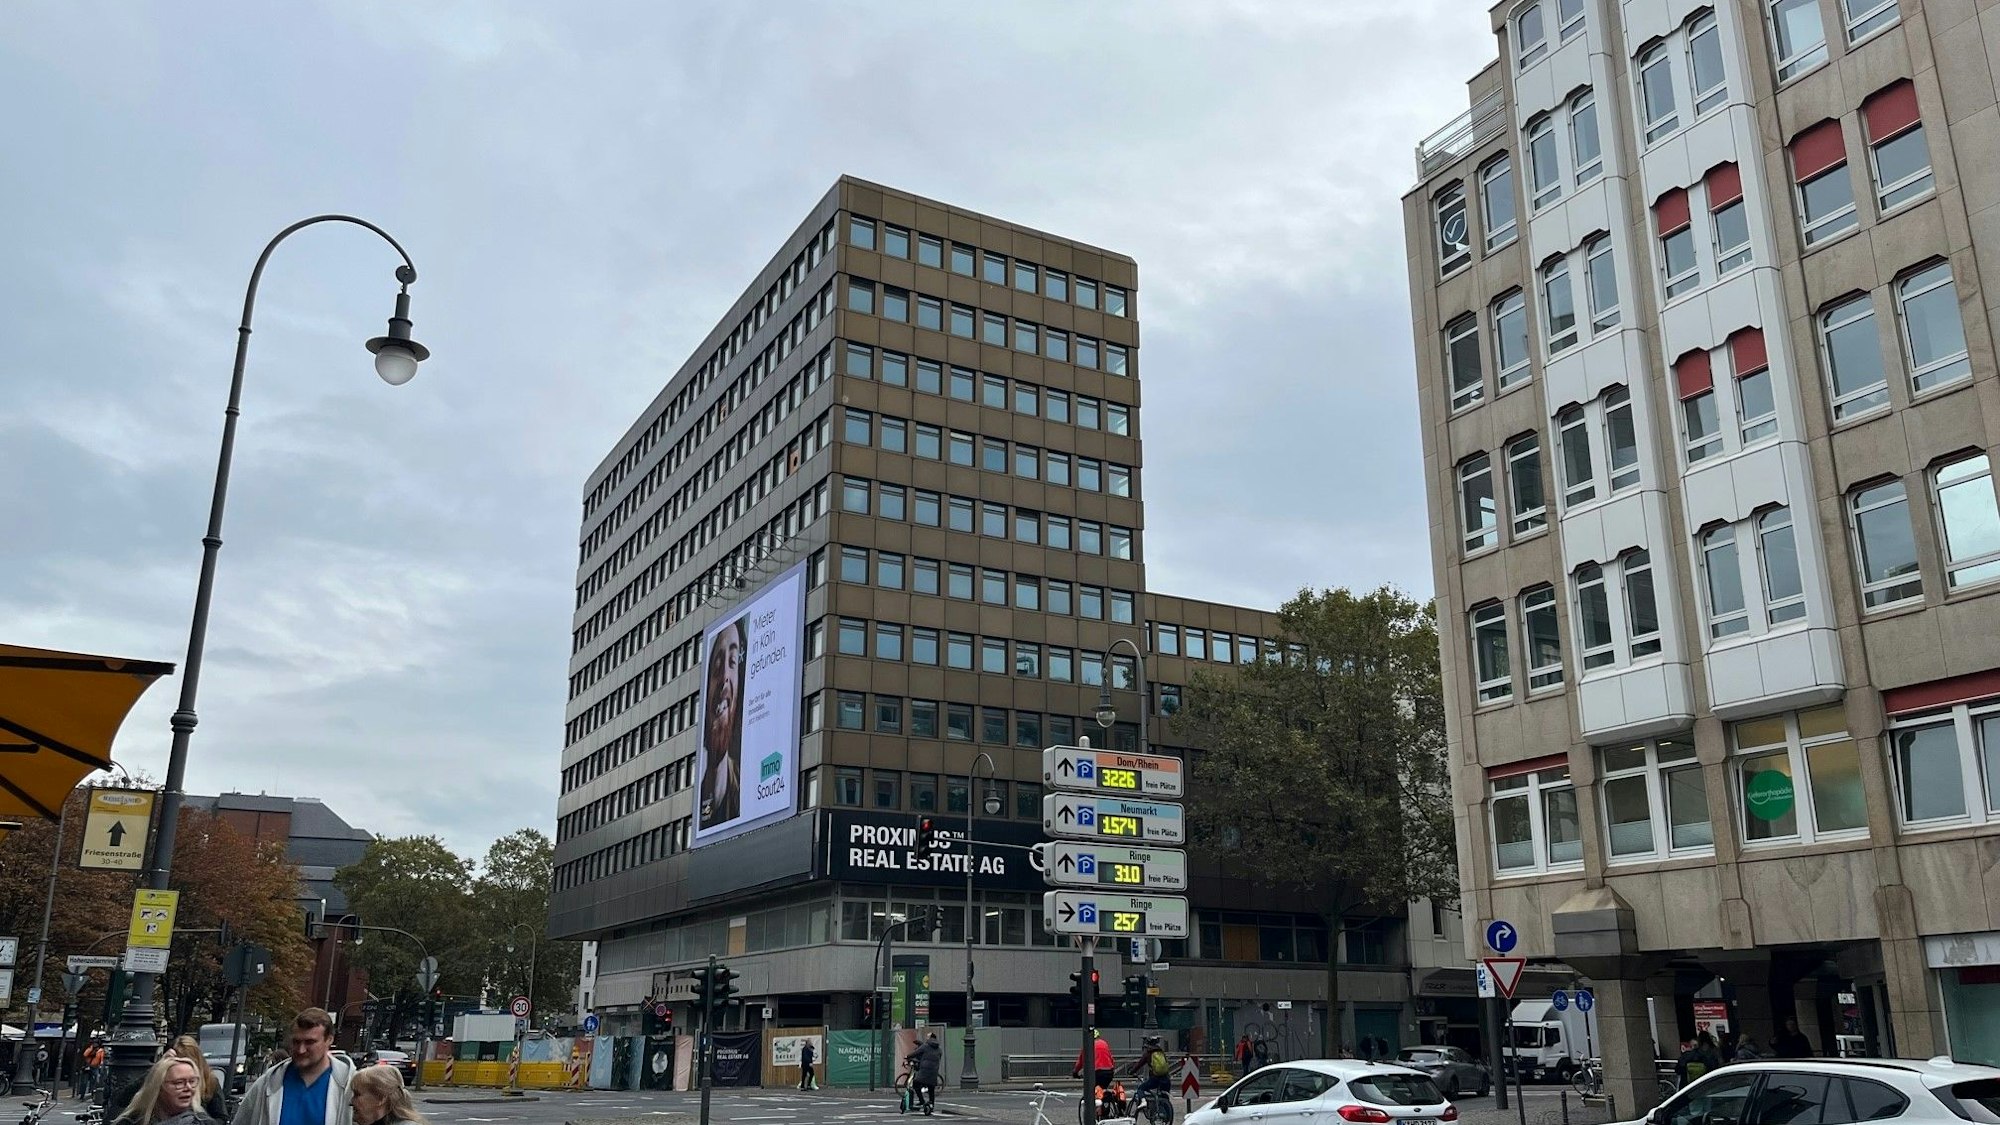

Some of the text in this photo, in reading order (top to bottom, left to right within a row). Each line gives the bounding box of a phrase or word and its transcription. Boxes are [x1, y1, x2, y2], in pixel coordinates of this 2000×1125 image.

[760, 628, 775, 649] Köln
[751, 646, 787, 679] gefunden.
[1117, 757, 1159, 770] Dom/Rhein
[757, 777, 785, 800] Scout24
[1082, 766, 1176, 790] P 3226 freie Plätze
[1121, 804, 1158, 816] Neumarkt
[1082, 812, 1178, 837] P 1574 freie Plätze
[84, 848, 142, 858] Friesenstraße
[849, 848, 1005, 875] REAL ESTATE AG
[1129, 850, 1151, 863] Ringe
[1083, 861, 1090, 872] P
[1114, 864, 1140, 883] 310
[1162, 875, 1180, 884] Plätze
[1130, 898, 1153, 911] Ringe
[1083, 910, 1091, 922] P
[1113, 912, 1140, 932] 257
[1164, 923, 1181, 931] Plätze
[515, 1002, 527, 1012] 30
